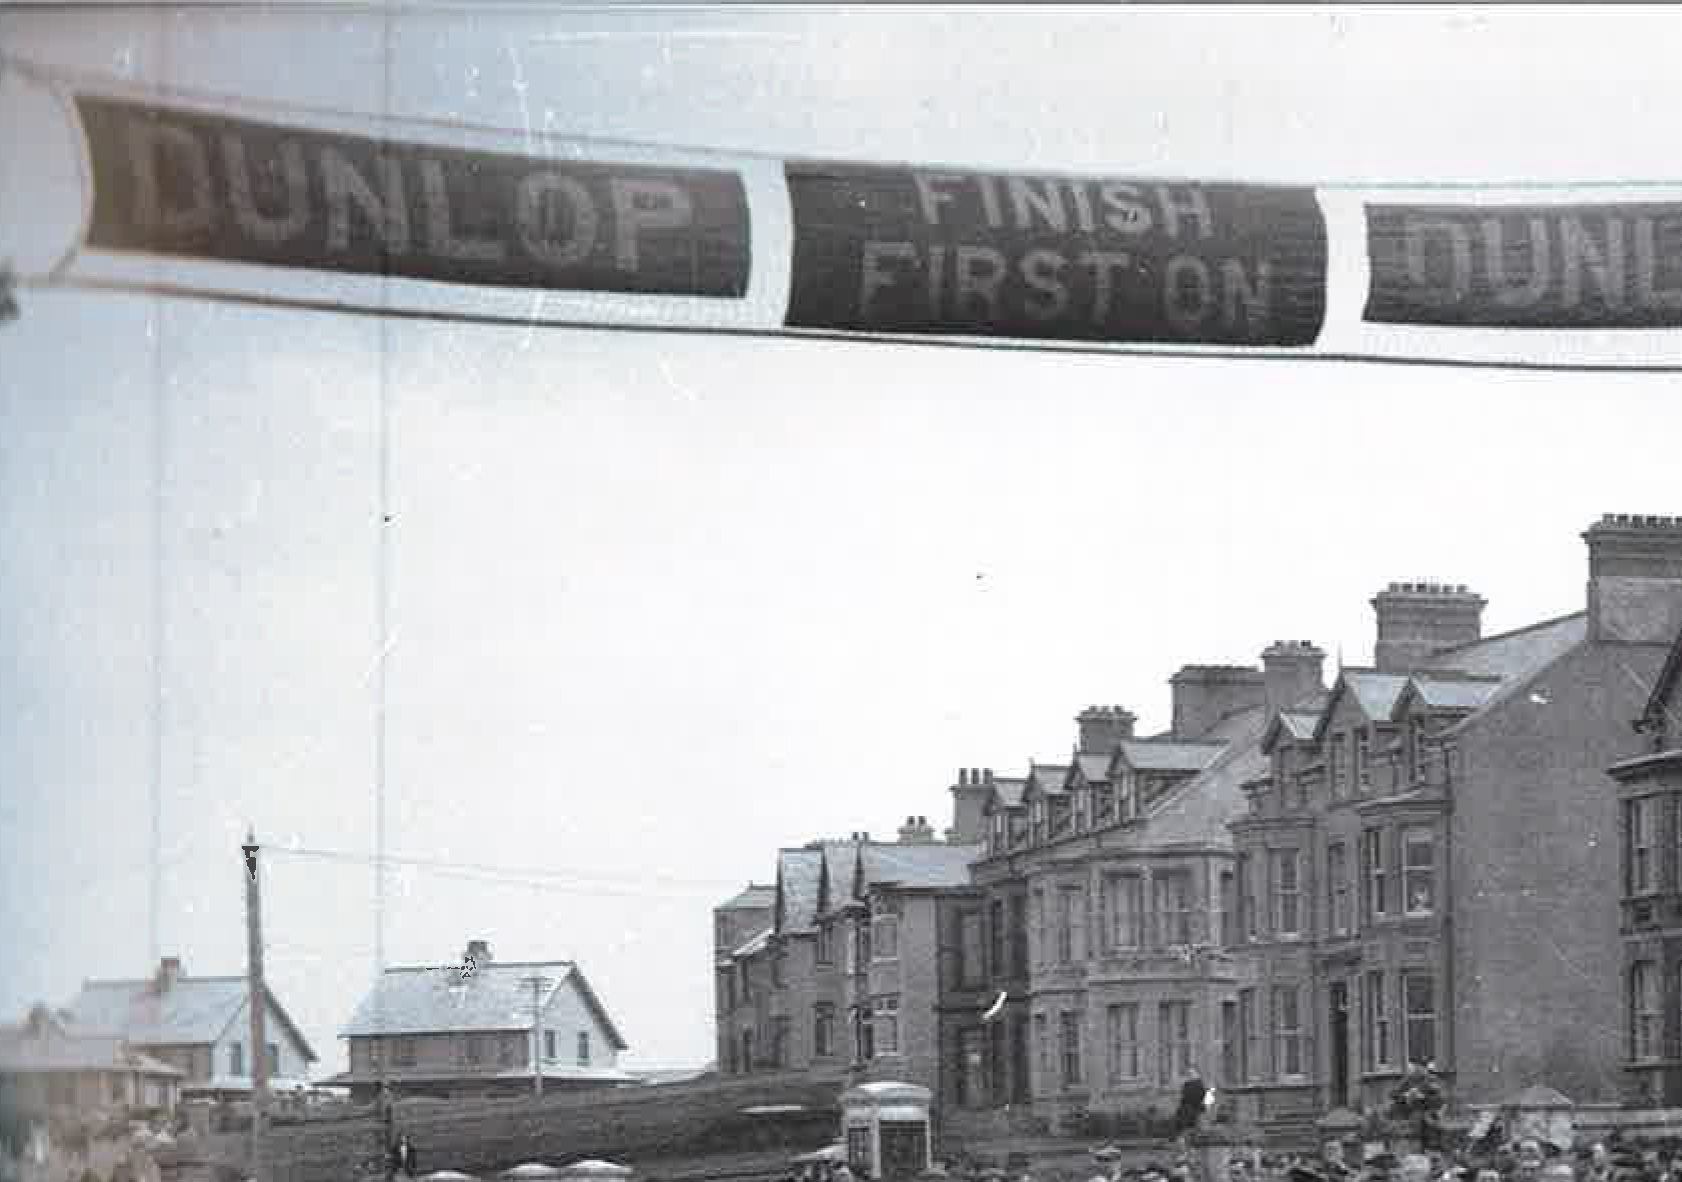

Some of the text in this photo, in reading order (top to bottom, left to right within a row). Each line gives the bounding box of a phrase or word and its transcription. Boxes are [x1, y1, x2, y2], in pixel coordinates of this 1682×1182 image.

[127, 119, 693, 272] DUNLOP
[910, 172, 1214, 238] FINISH
[858, 239, 1272, 325] FIRST ON
